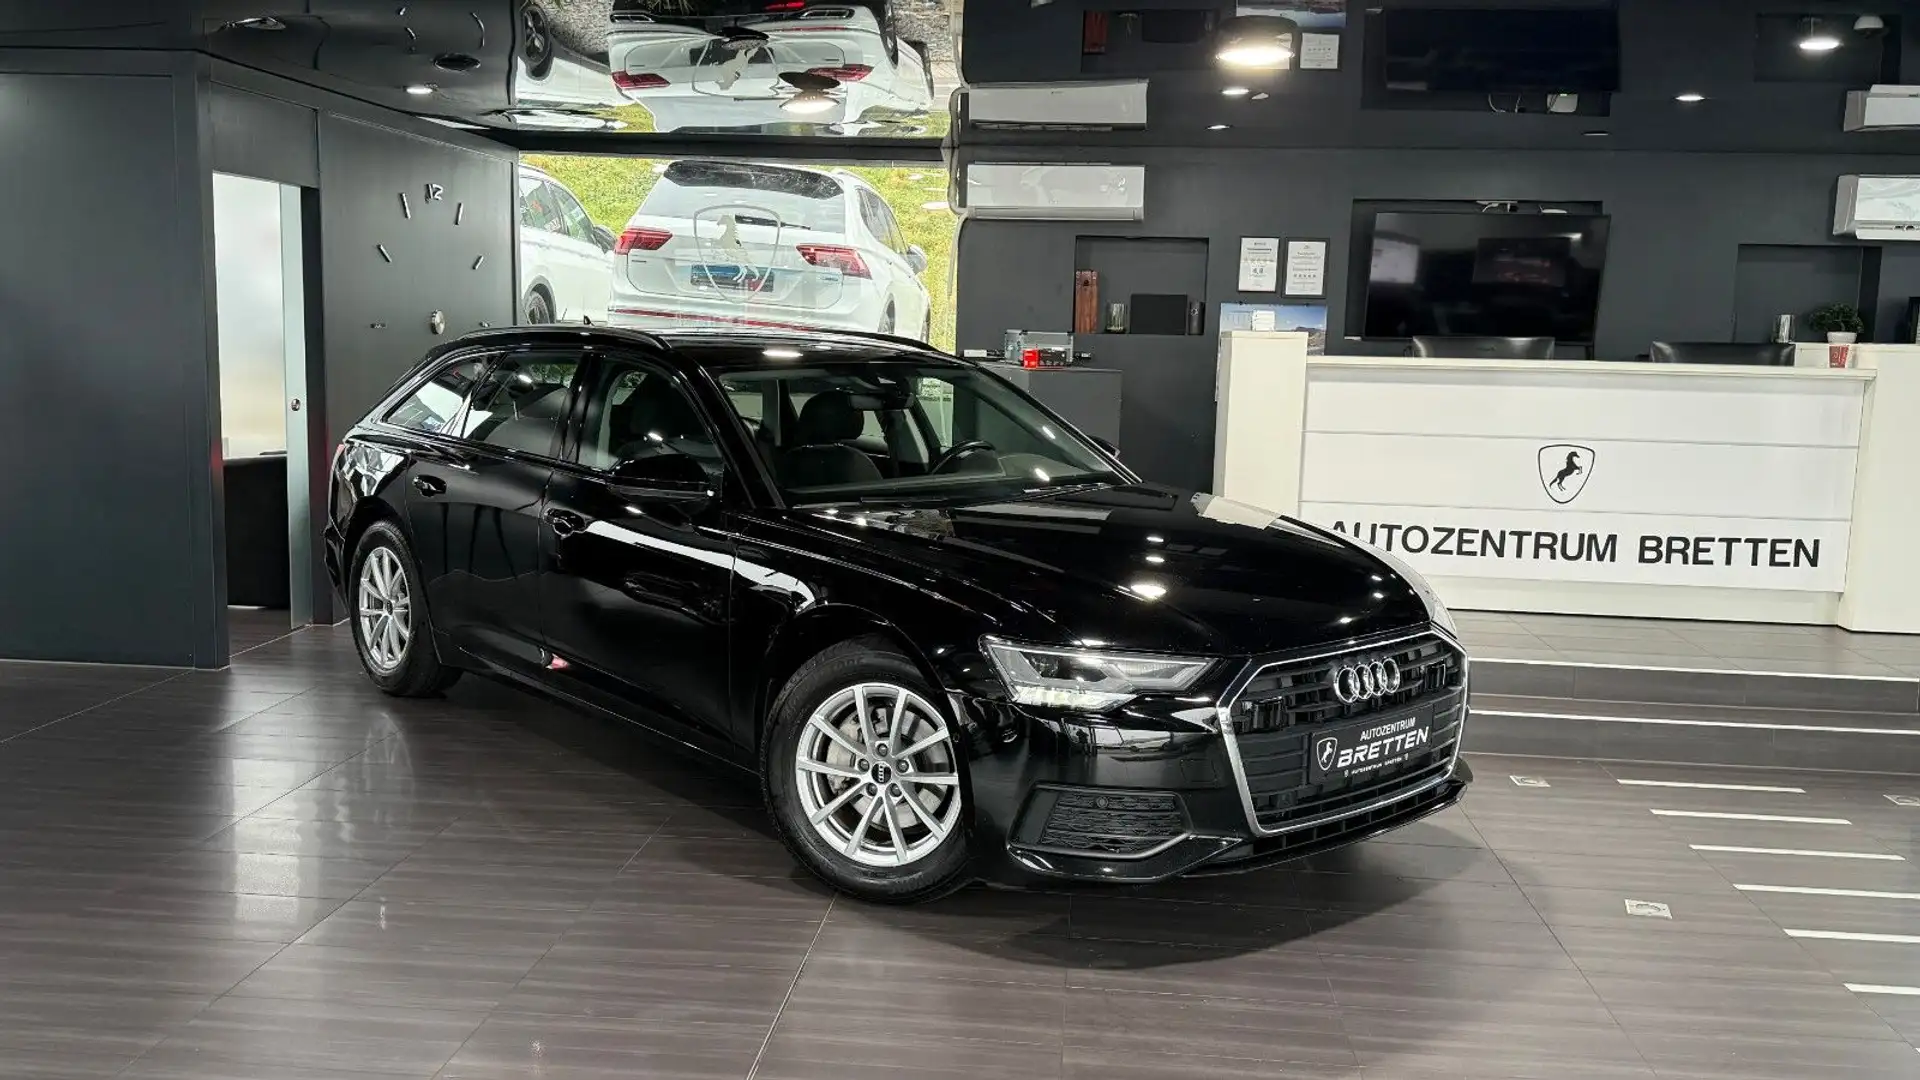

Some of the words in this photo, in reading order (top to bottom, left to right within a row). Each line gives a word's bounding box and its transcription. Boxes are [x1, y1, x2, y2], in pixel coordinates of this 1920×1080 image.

[426, 183, 443, 200] 12
[1638, 535, 1820, 567] BRETTEN
[1360, 716, 1416, 741] AUTOZENTRUM
[1337, 726, 1429, 768] BRETTEN
